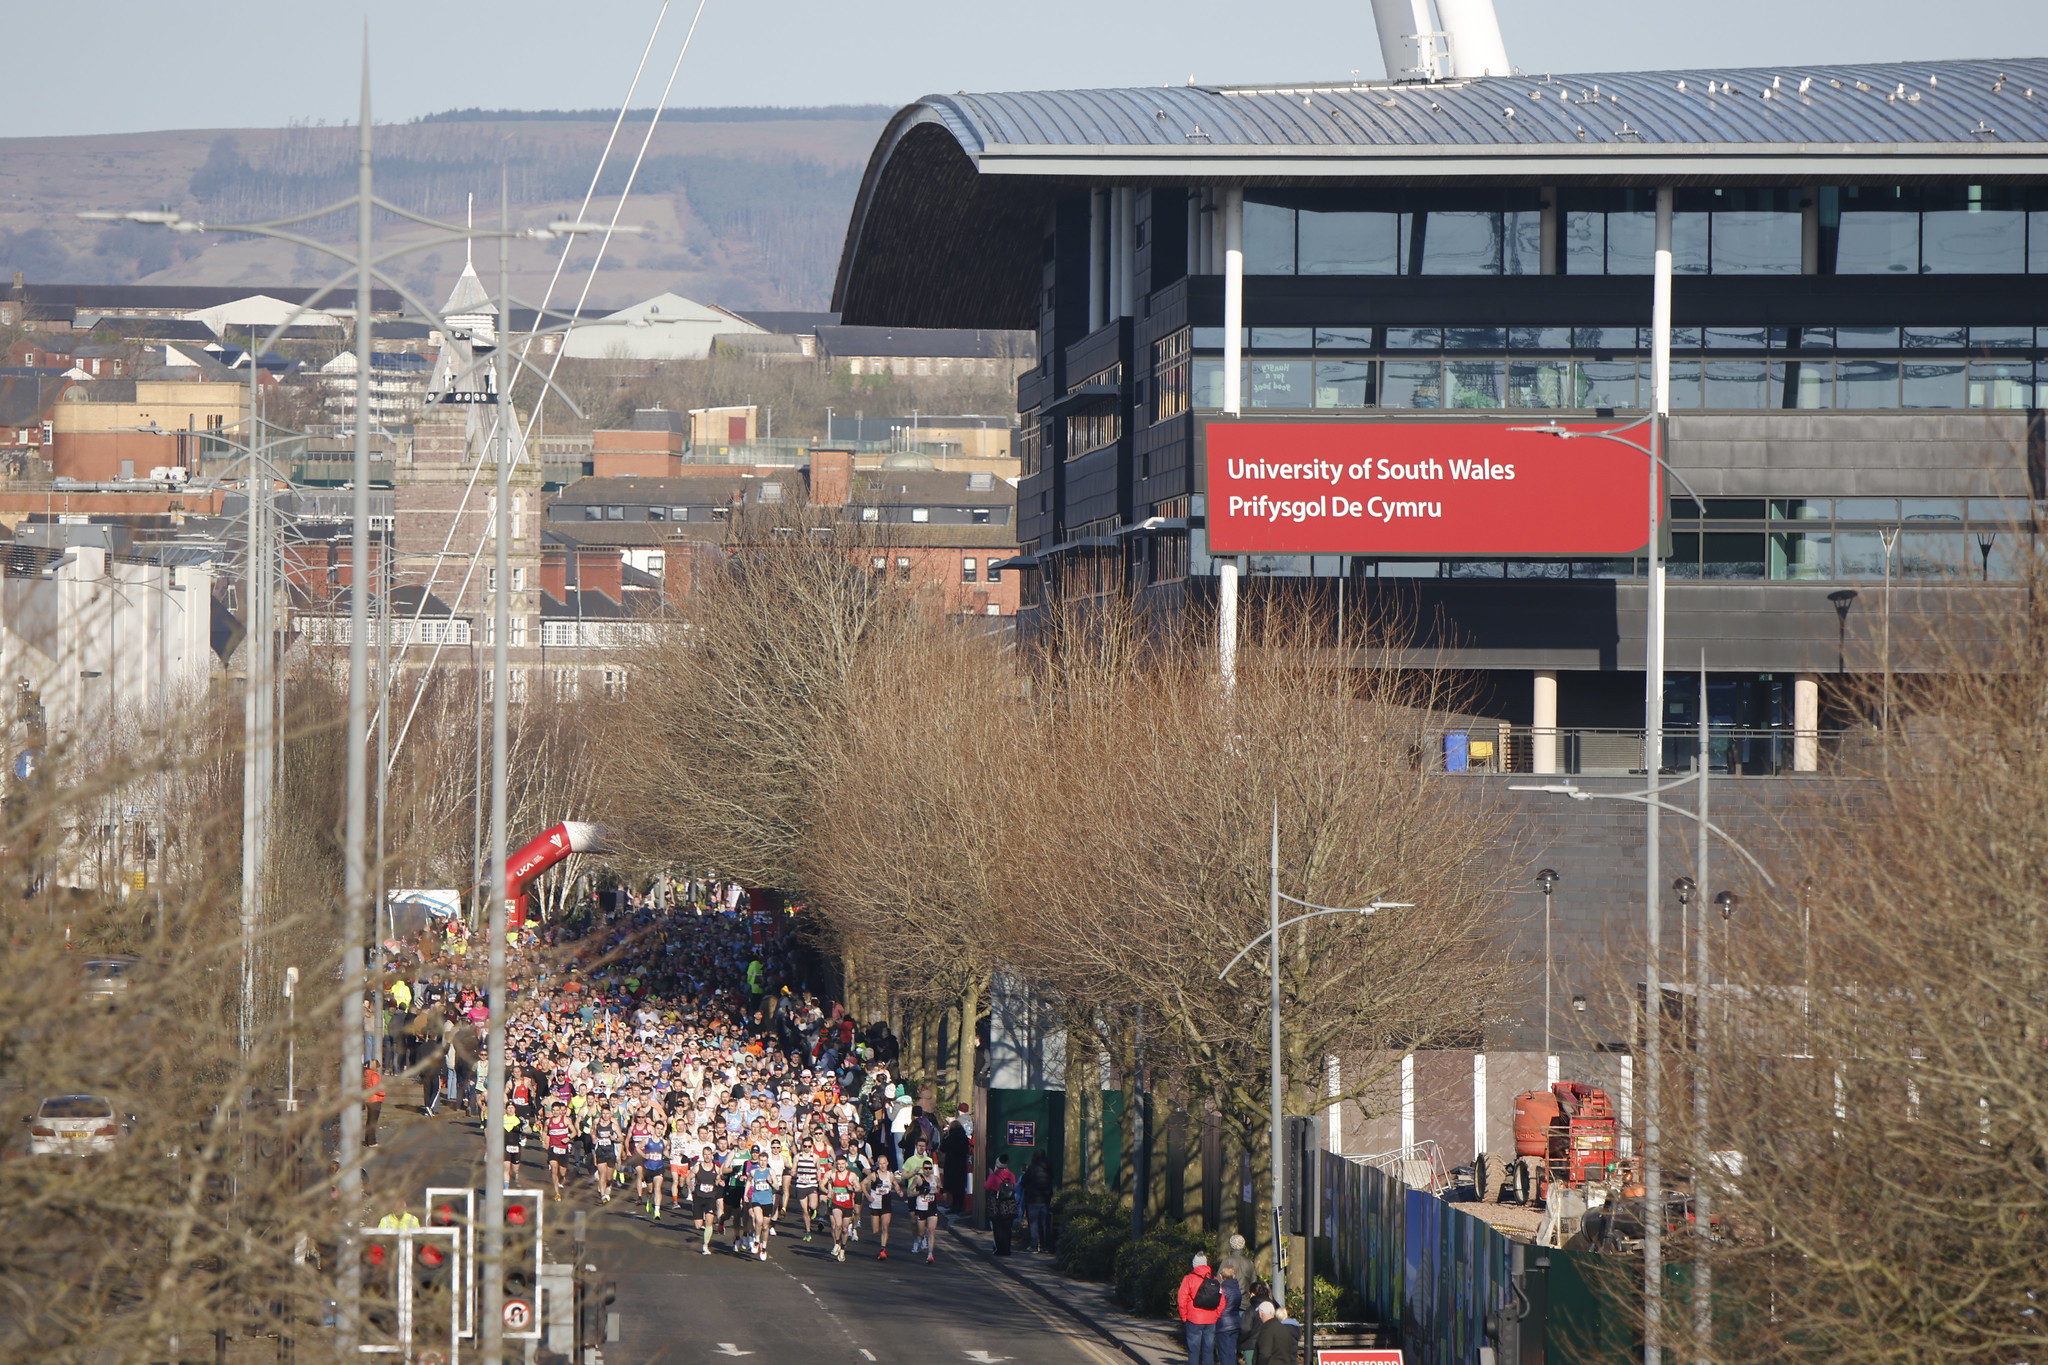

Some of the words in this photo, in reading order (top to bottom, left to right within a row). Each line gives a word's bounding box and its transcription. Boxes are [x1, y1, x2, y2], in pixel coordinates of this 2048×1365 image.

[1227, 457, 1344, 486] University
[1347, 457, 1373, 480] of
[1376, 457, 1443, 480] South
[1448, 457, 1516, 480] Wales
[1229, 494, 1327, 523] Prifysgol
[1331, 496, 1363, 517] De
[1367, 495, 1442, 523] Cymru
